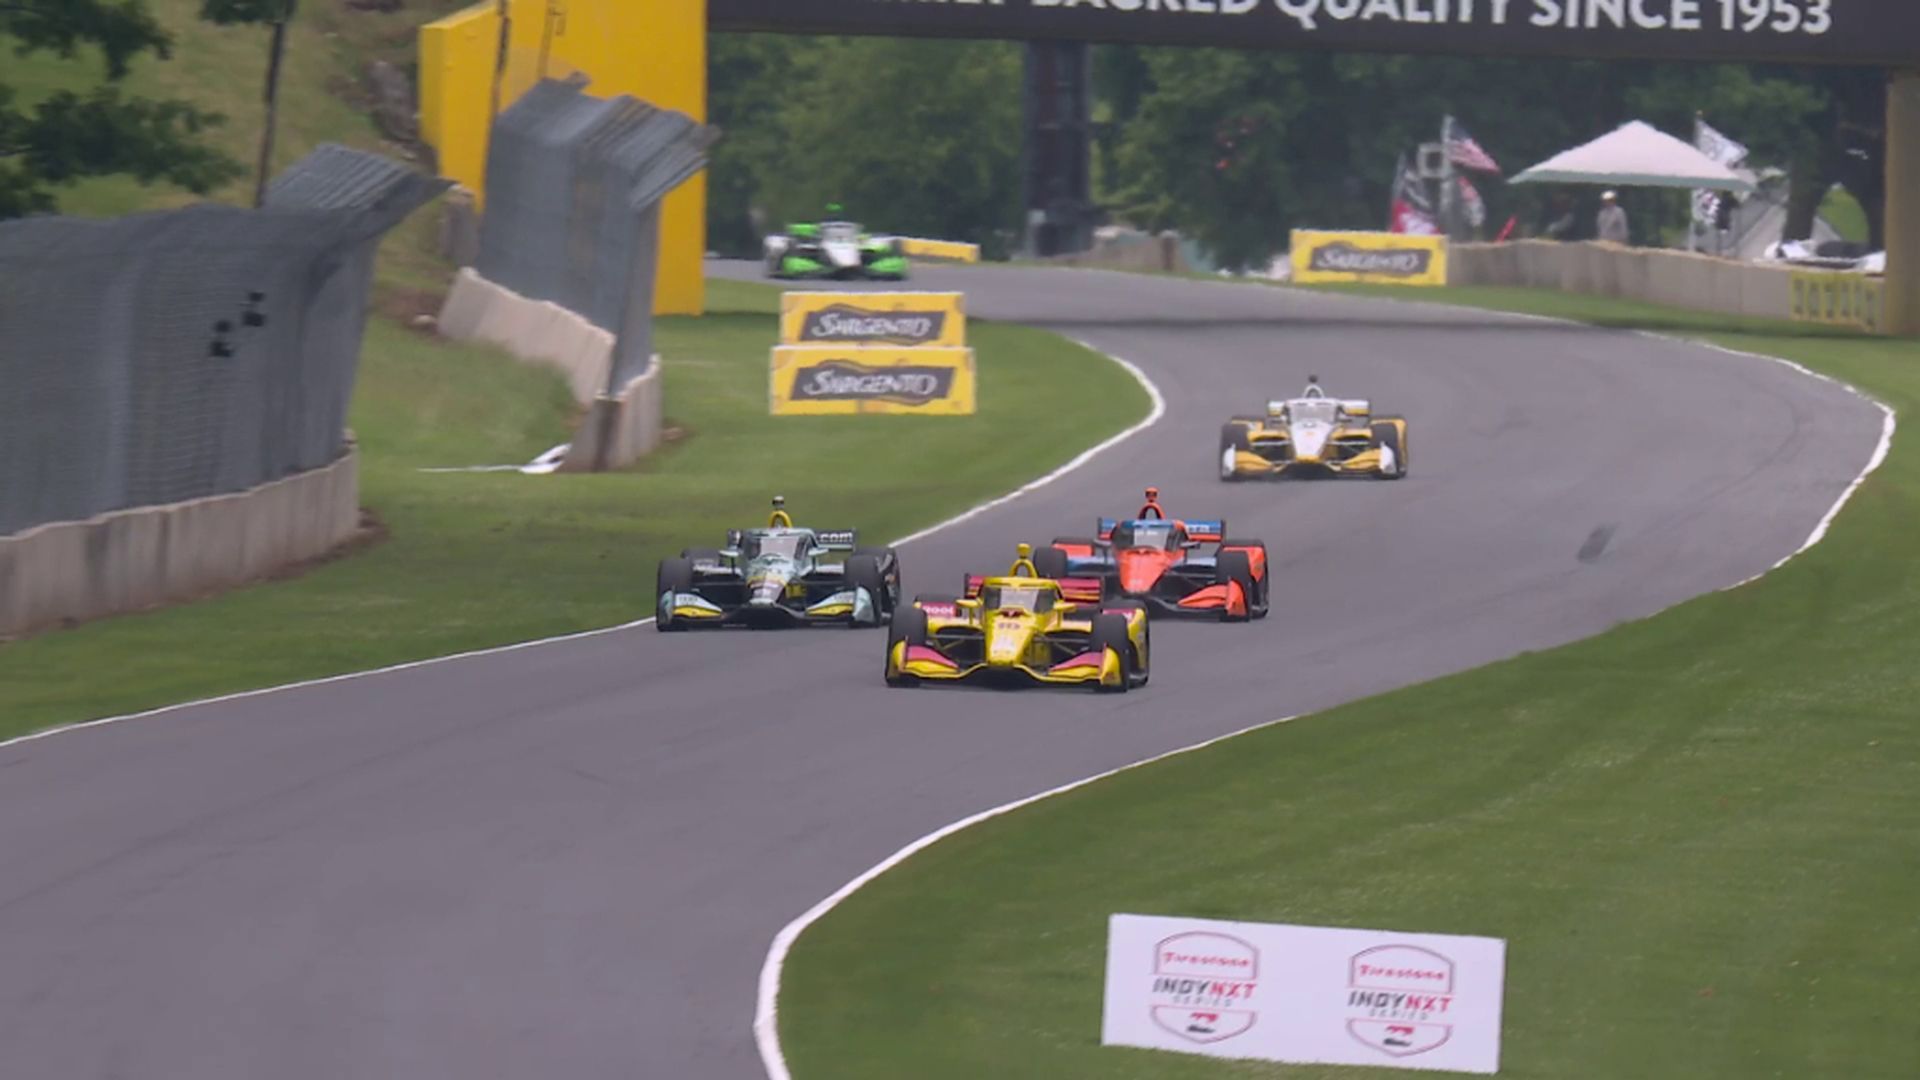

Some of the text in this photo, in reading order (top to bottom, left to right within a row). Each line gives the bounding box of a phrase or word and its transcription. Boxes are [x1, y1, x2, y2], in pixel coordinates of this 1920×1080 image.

[1529, 0, 1701, 30] SINCE
[1717, 0, 1832, 34] 1953
[811, 312, 932, 338] SARGENTO
[802, 369, 939, 396] SARGENTO
